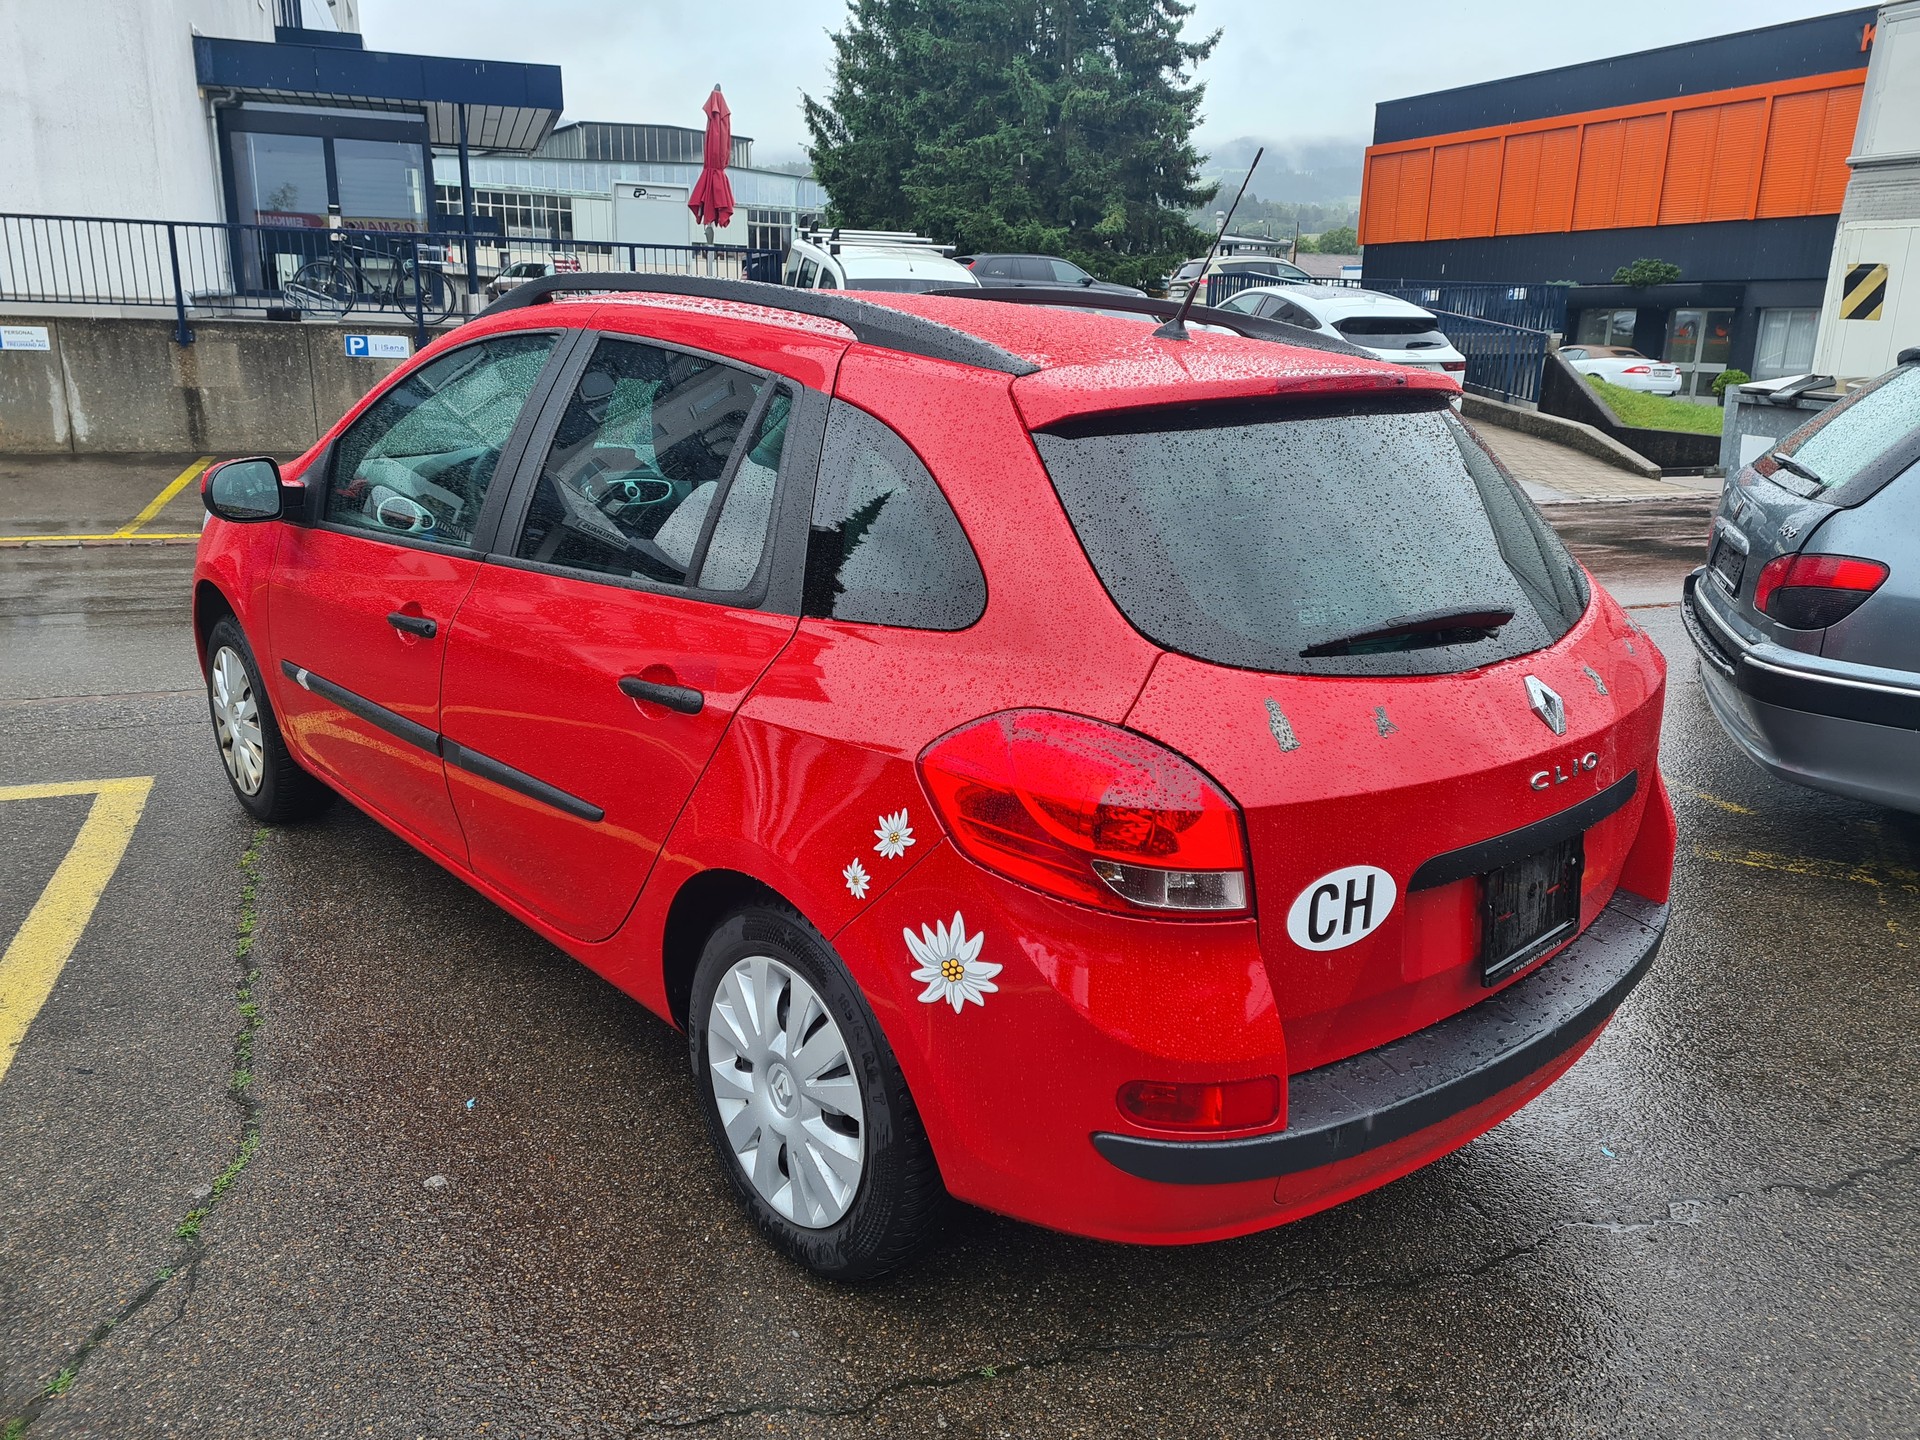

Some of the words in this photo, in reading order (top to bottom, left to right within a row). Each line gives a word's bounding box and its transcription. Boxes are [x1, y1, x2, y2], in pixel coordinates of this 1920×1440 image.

[350, 338, 364, 355] P
[1779, 524, 1800, 539] 406
[1531, 752, 1598, 790] CLIO
[1308, 873, 1375, 944] CH
